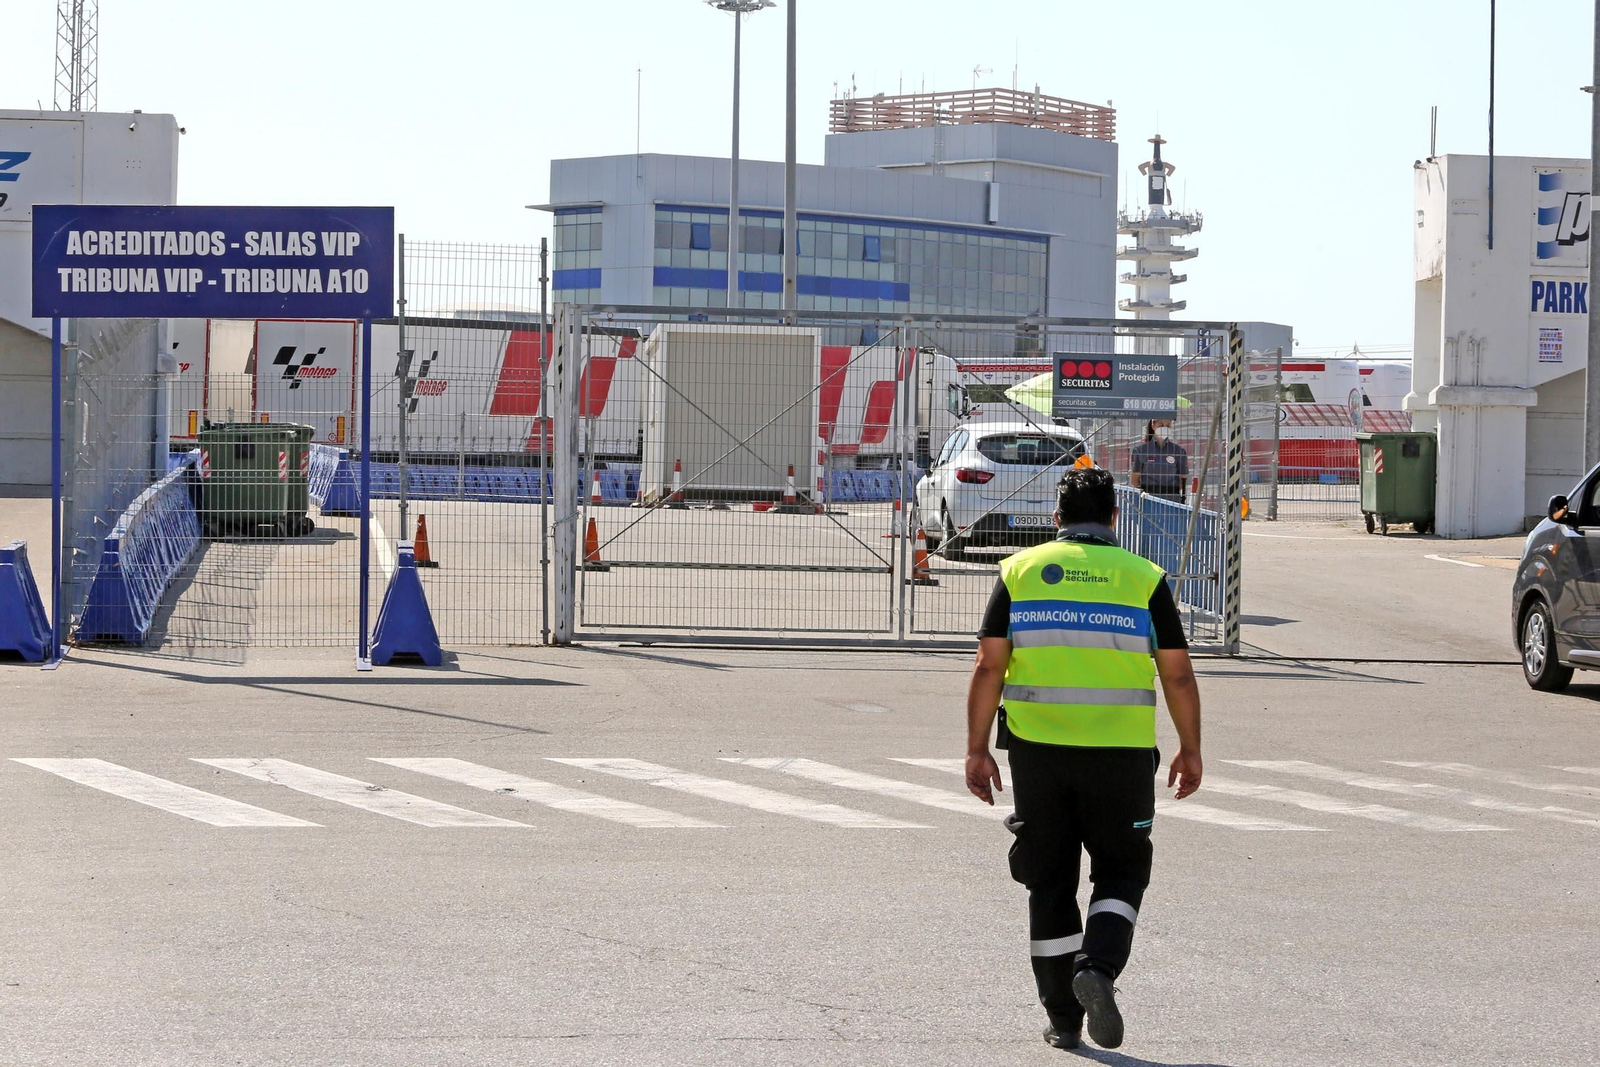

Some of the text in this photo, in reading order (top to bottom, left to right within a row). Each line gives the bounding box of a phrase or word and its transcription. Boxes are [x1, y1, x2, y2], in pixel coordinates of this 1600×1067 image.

[66, 230, 226, 256] ACREDITADOS
[244, 230, 317, 256] SALAS
[321, 231, 361, 256] VIP
[57, 267, 160, 293] TRIBUNA
[163, 267, 203, 293] VIP
[221, 268, 323, 293] TRIBUNA
[326, 268, 369, 294] A10
[1531, 280, 1588, 314] PARK
[1118, 362, 1165, 371] Instalación
[1118, 372, 1160, 383] Protegida
[1061, 378, 1110, 388] SECURITAS
[1058, 398, 1097, 407] securitas.es
[1123, 399, 1175, 410] 618 007 694
[1015, 516, 1038, 525] 0900
[1065, 569, 1089, 577] servi
[1065, 575, 1109, 583] securitas
[1079, 612, 1087, 623] Y
[1088, 613, 1136, 629] CONTROL
